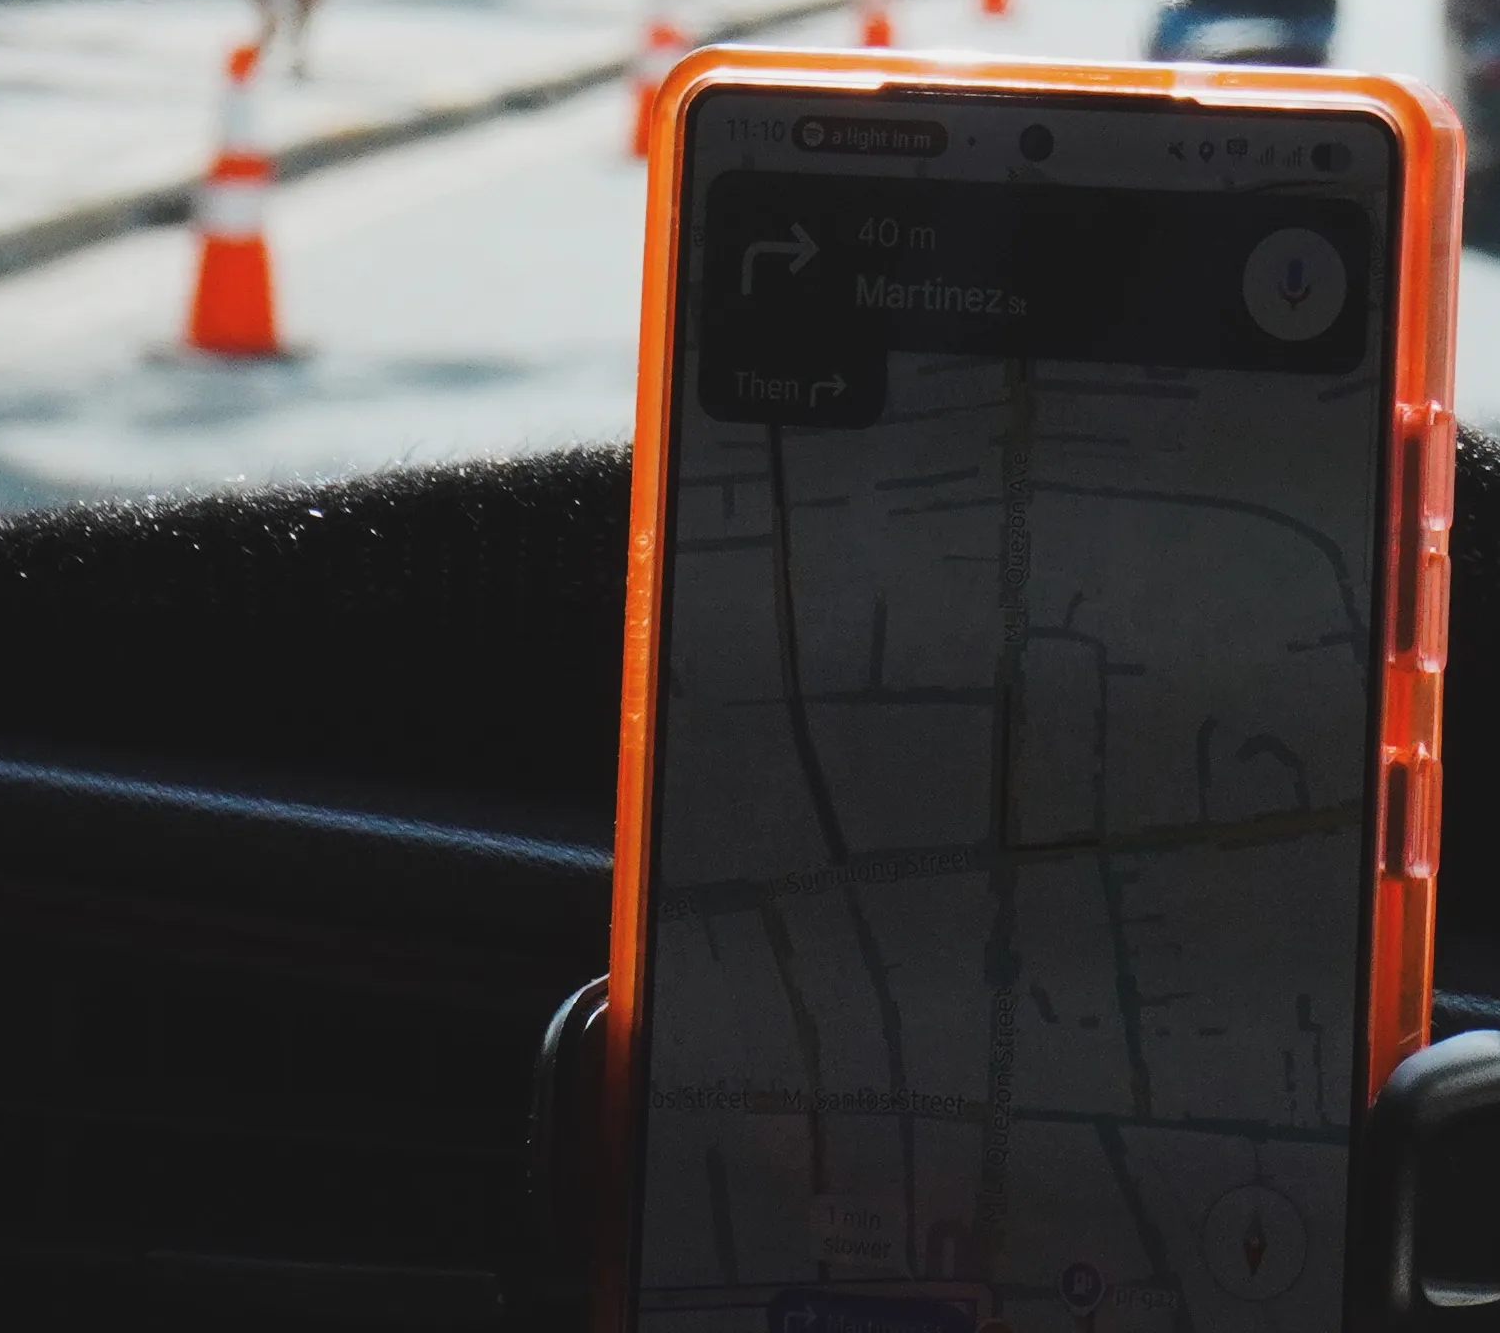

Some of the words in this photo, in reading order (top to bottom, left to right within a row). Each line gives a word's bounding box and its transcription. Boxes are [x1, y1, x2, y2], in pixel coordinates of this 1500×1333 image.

[726, 117, 786, 142] 11:10
[831, 131, 842, 145] a
[846, 122, 888, 151] light
[892, 129, 909, 148] in
[858, 217, 899, 249] 40
[909, 226, 936, 250] m
[855, 273, 1003, 314] Martinez
[1008, 296, 1028, 316] St
[734, 369, 800, 401] Then
[1009, 452, 1028, 492] Ave
[1005, 501, 1026, 585] Quezon
[786, 860, 899, 895] Sumulong
[904, 848, 971, 876] Street
[993, 987, 1015, 1063] Street
[682, 1087, 750, 1110] Street
[814, 1088, 891, 1112] Santos
[898, 1088, 966, 1116] Street
[986, 1074, 1011, 1166] Quezon
[844, 1209, 882, 1230] min
[823, 1234, 892, 1259] slower
